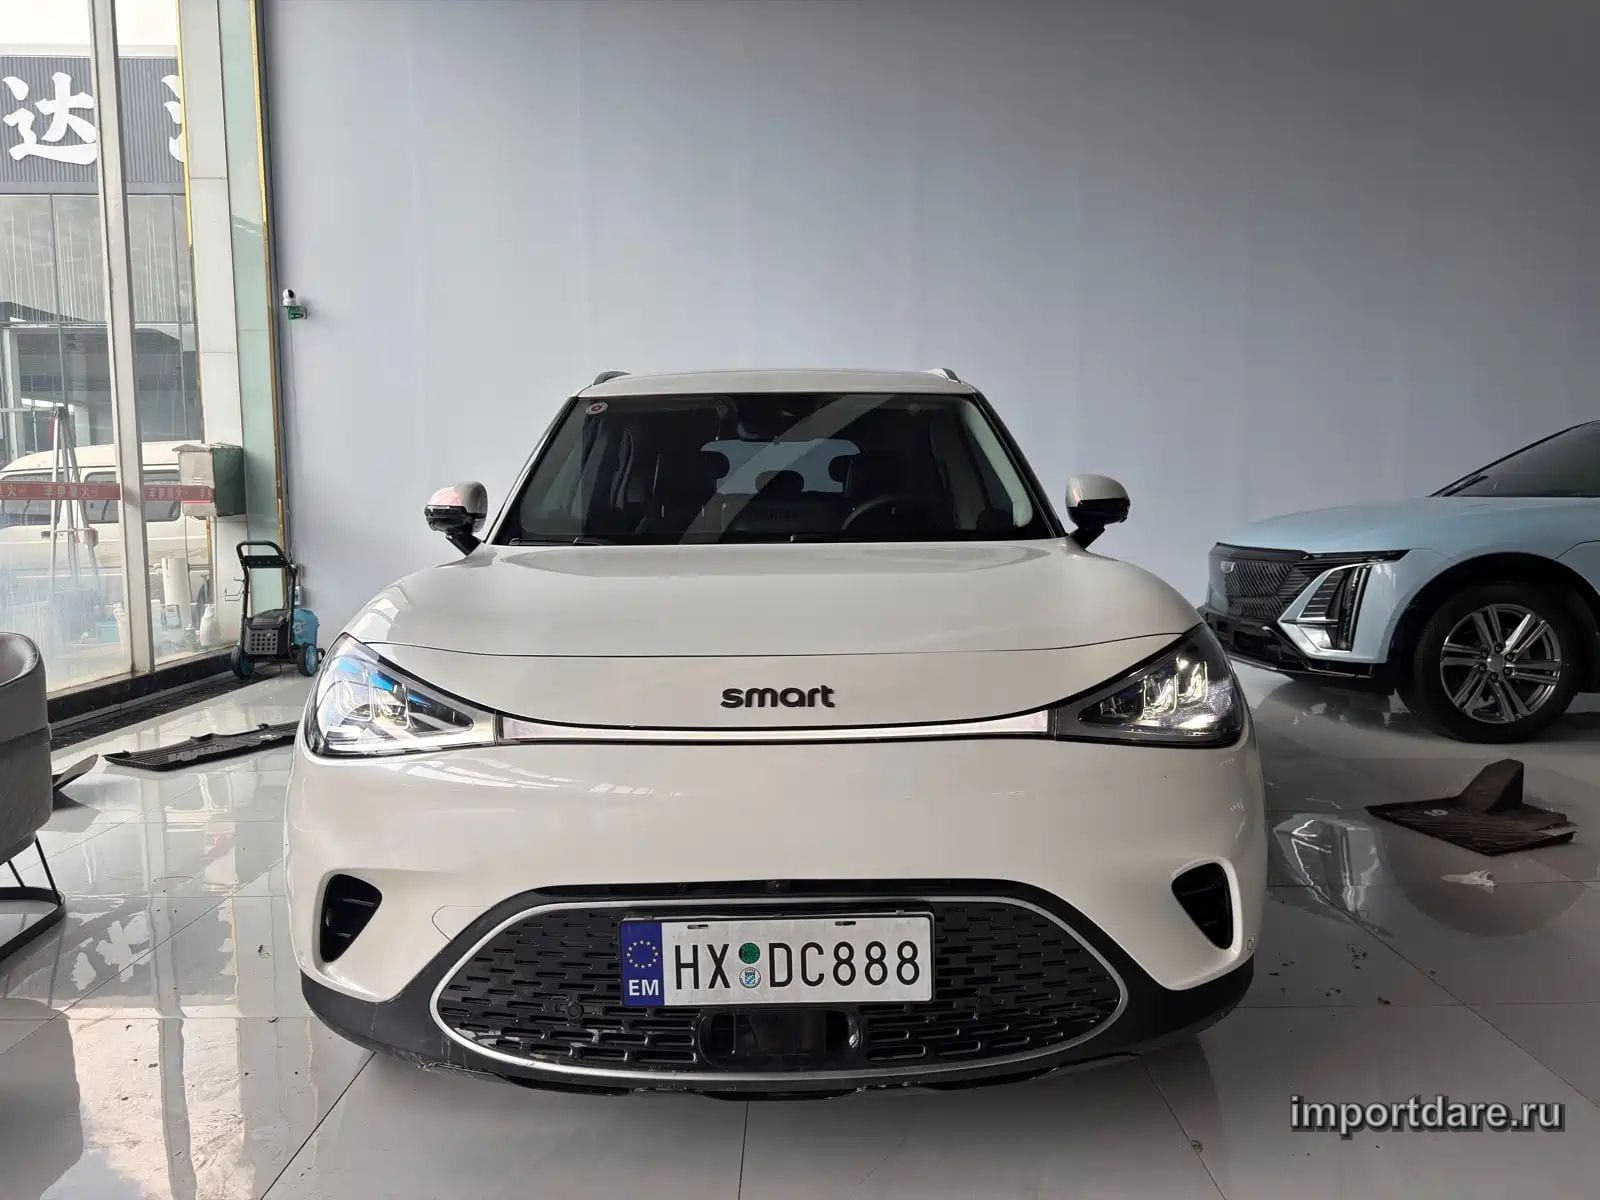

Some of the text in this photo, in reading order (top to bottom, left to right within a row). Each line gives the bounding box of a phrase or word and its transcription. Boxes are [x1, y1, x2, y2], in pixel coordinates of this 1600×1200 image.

[2, 71, 98, 165] 达
[720, 685, 835, 708] smart
[675, 943, 731, 989] HX
[768, 940, 920, 988] DC888
[628, 979, 659, 996] EM
